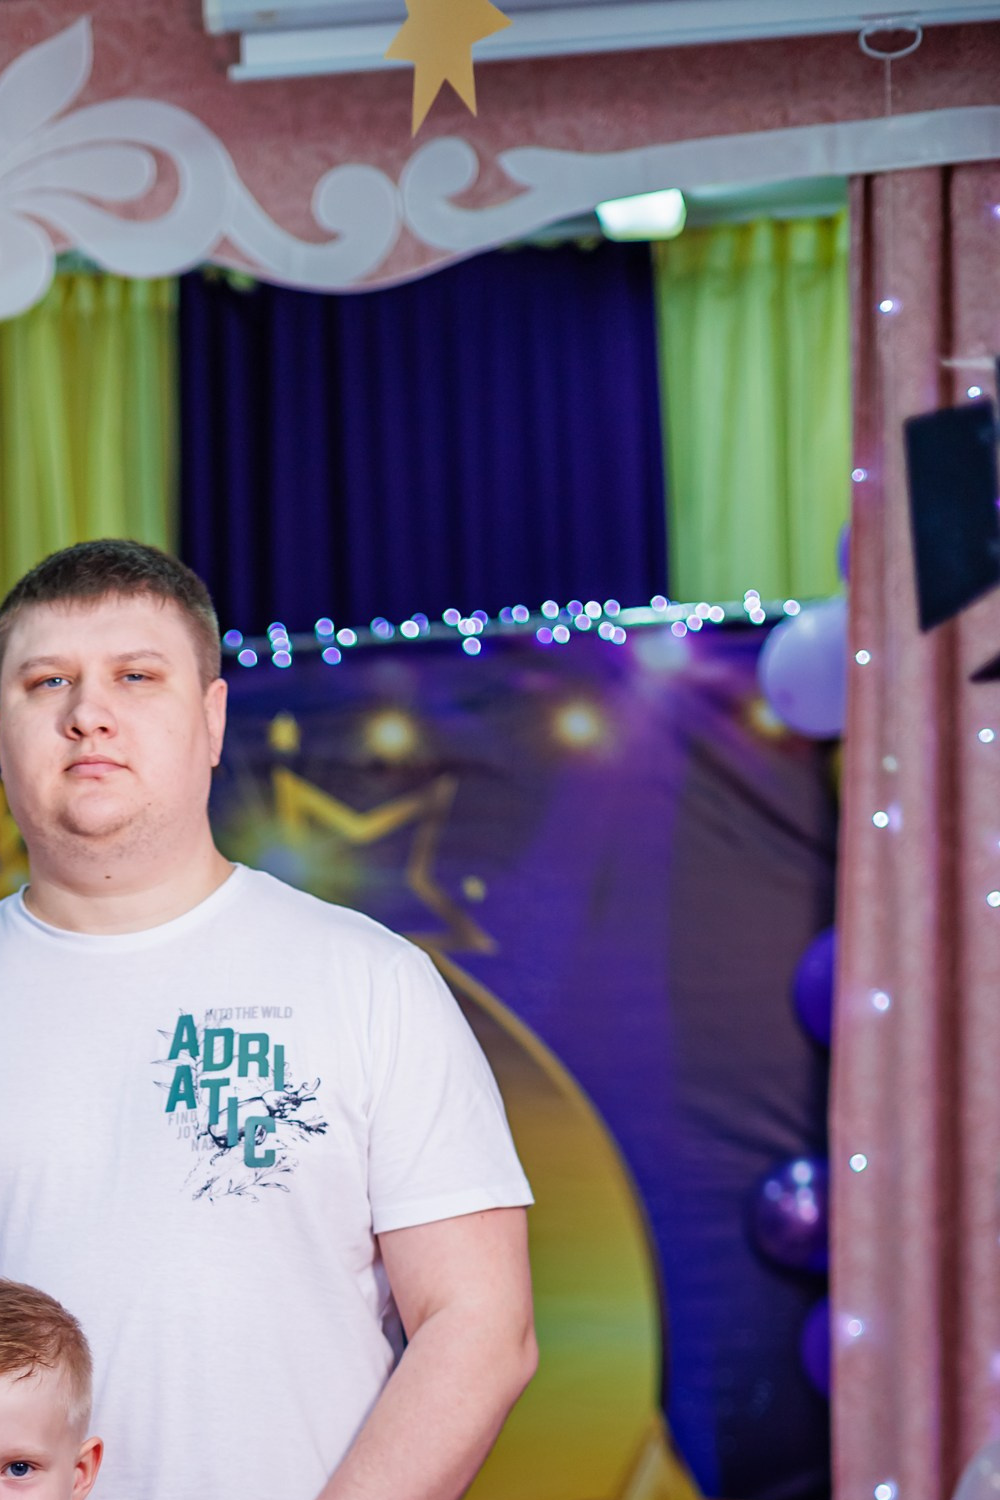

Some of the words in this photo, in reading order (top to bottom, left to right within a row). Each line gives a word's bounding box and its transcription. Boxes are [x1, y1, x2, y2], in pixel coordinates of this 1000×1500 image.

[235, 1006, 259, 1020] THE
[261, 1005, 293, 1019] WILD
[168, 1014, 285, 1092] ADRI
